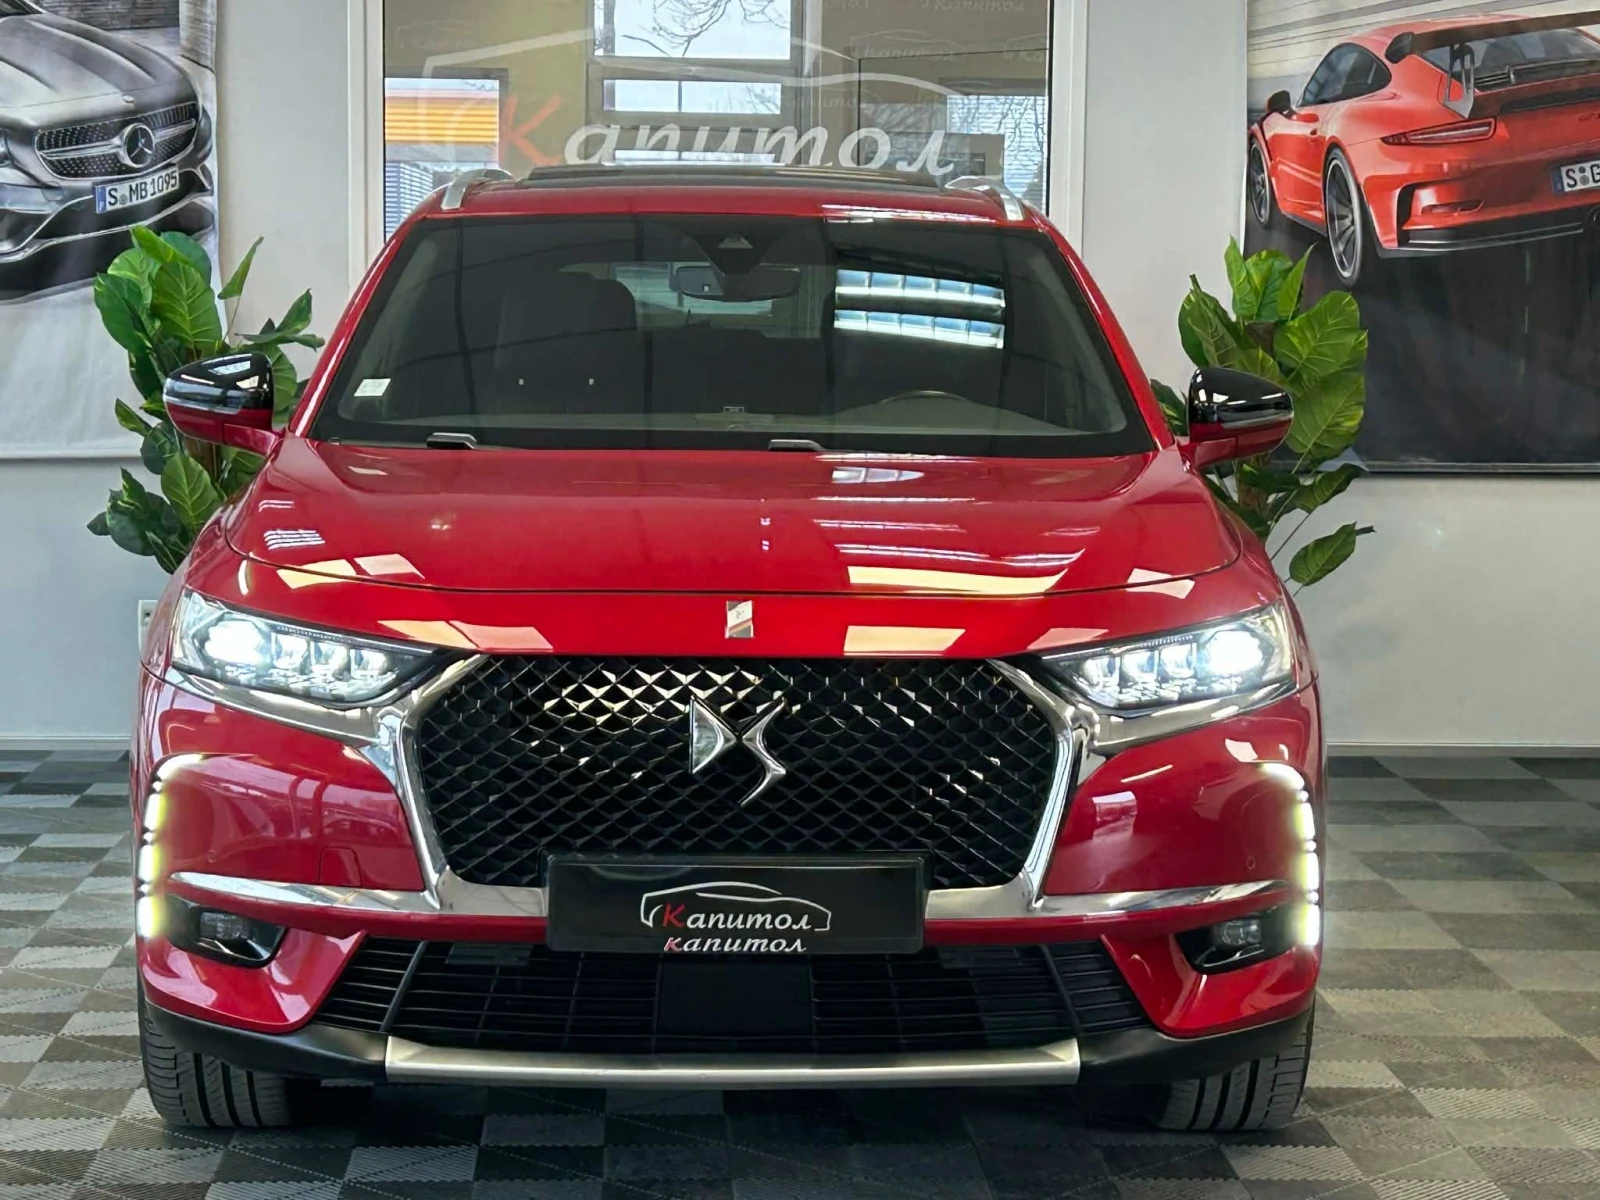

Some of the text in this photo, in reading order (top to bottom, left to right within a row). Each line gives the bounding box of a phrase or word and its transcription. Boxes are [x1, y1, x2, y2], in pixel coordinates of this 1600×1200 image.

[500, 94, 954, 176] Капитол
[108, 171, 177, 206] S MB 1095
[1565, 168, 1578, 189] S
[662, 903, 812, 929] Капитол
